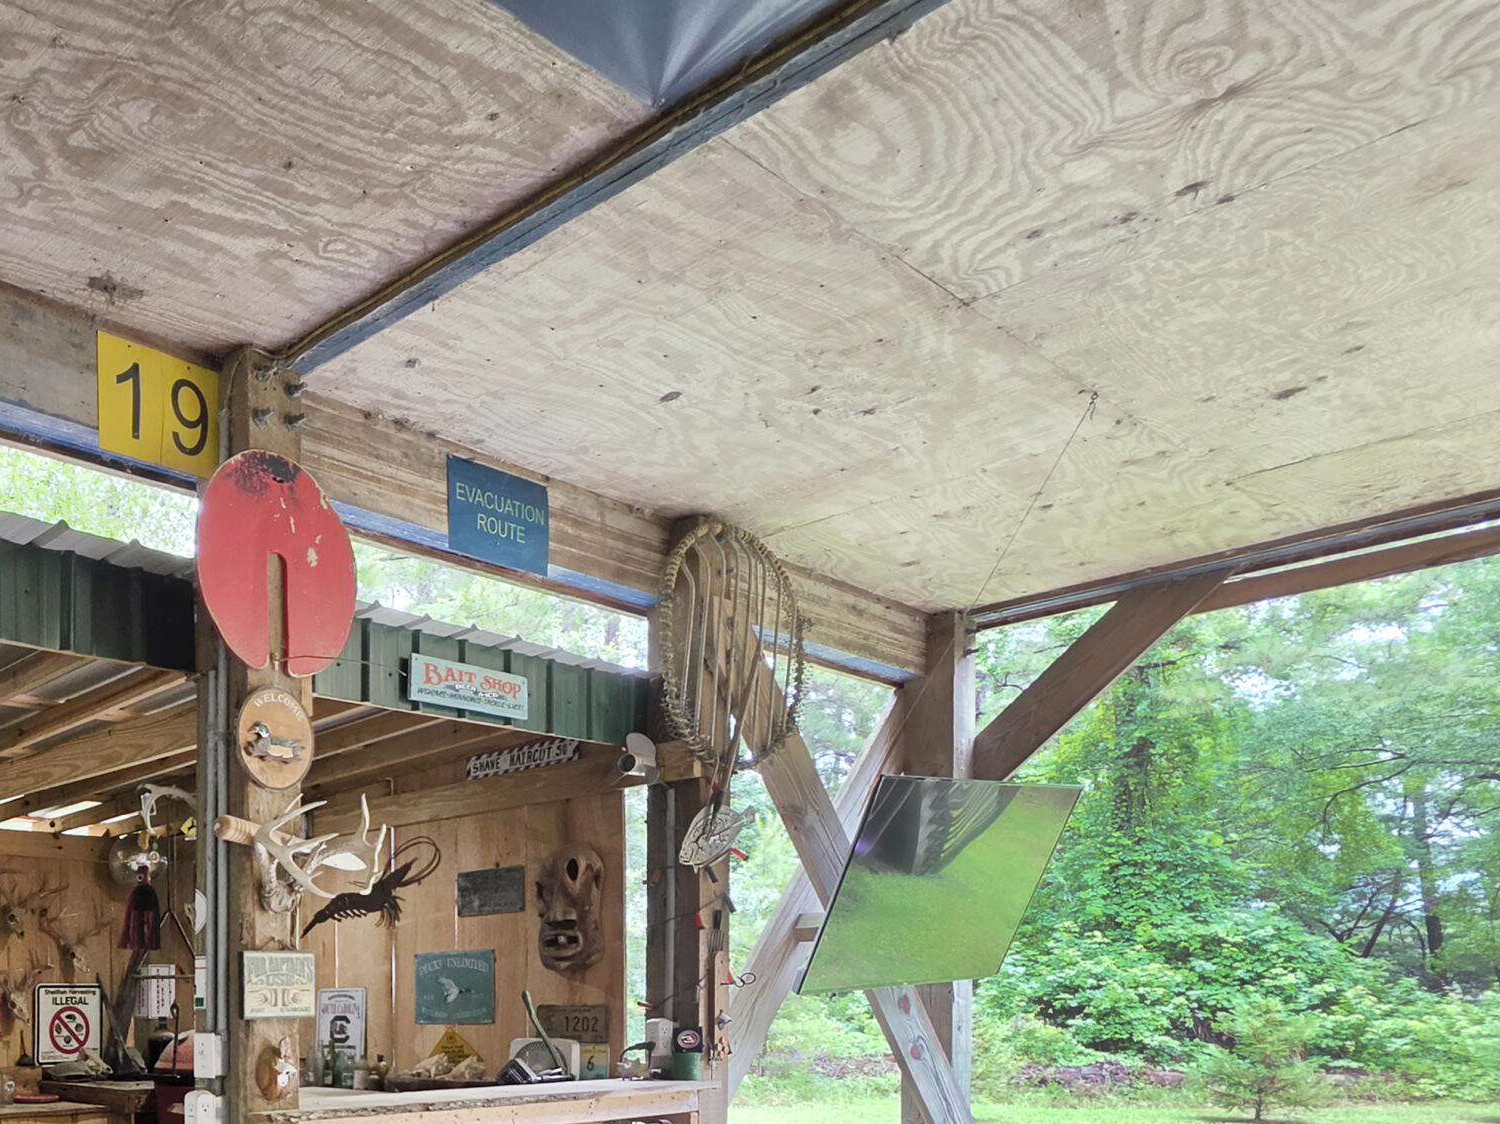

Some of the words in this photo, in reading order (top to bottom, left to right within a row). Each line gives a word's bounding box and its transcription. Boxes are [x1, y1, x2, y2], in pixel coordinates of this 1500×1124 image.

[456, 482, 545, 526] EVACUATION
[477, 513, 526, 544] ROUTE
[423, 662, 477, 686] BAIT
[480, 675, 522, 700] SHOP
[253, 692, 306, 721] WELCOME
[472, 758, 500, 774] SHAVE
[509, 746, 552, 767] HAIRCUT
[52, 997, 89, 1005] ILLEGAL
[564, 1015, 599, 1033] 1202
[586, 1055, 595, 1072] 6
